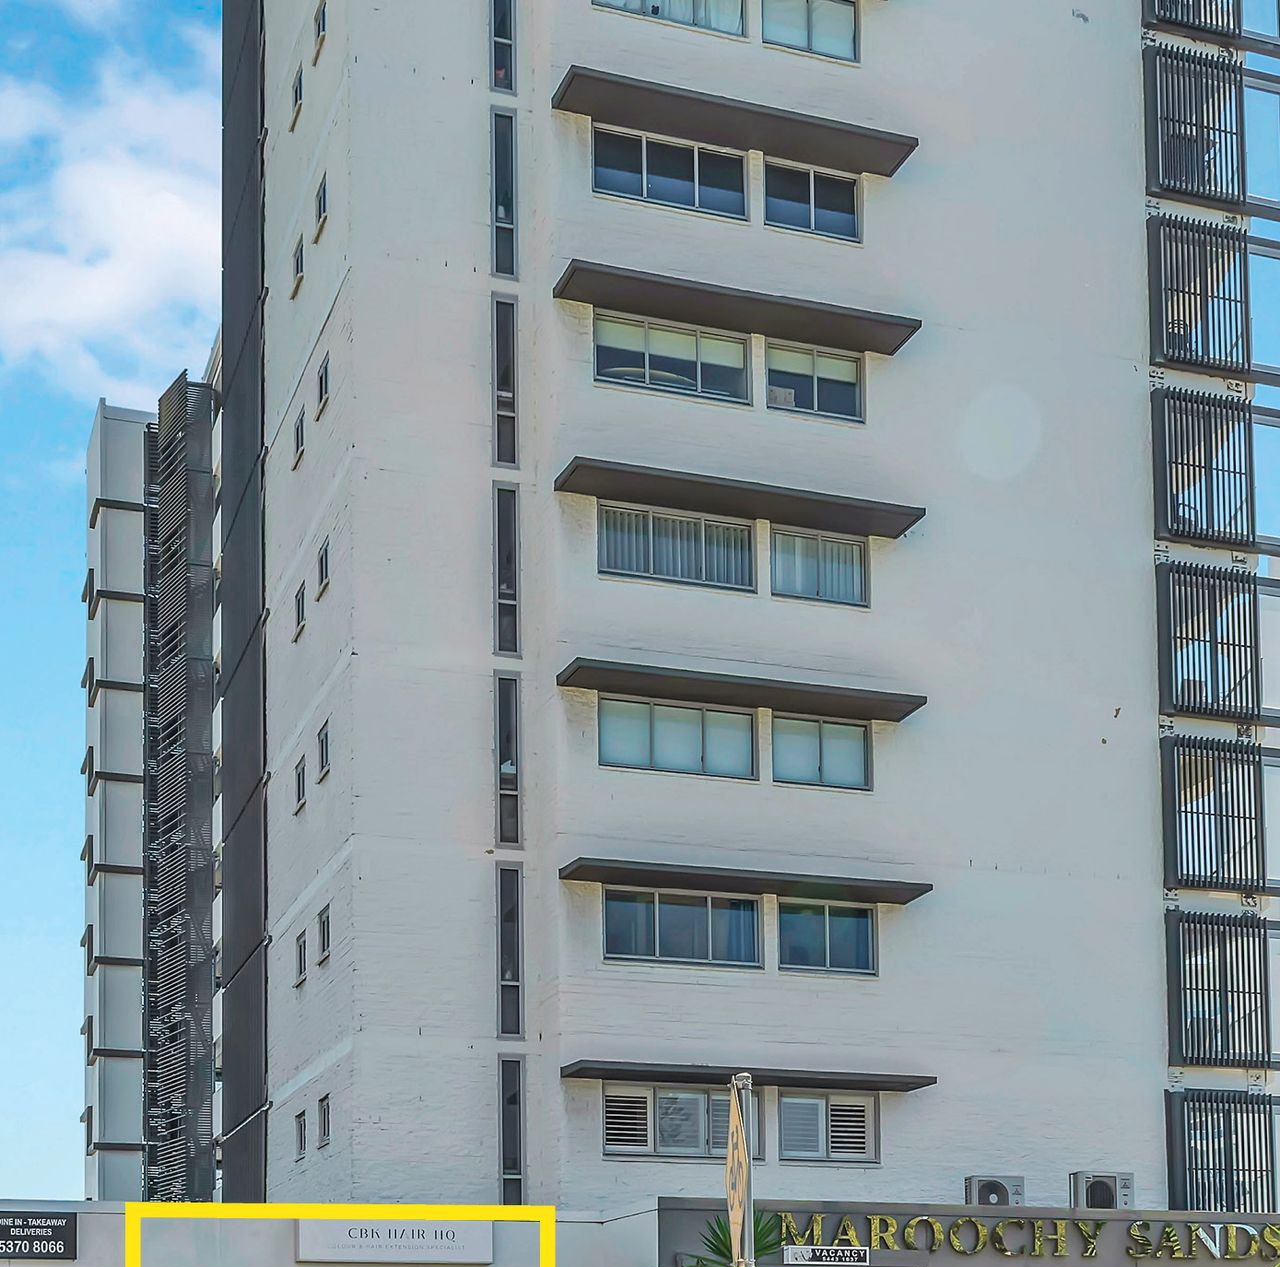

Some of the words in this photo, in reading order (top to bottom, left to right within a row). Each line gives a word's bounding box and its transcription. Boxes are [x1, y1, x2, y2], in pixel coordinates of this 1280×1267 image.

[14, 1218, 23, 1226] IN
[27, 1218, 67, 1226] TAKEAWAY
[10, 1228, 52, 1236] DELIVERIES
[348, 1227, 381, 1240] CBK
[388, 1228, 426, 1240] HAIR
[777, 1211, 1108, 1258] MAROOCHY
[33, 1241, 64, 1253] 8066
[815, 1249, 865, 1257] VACANCY
